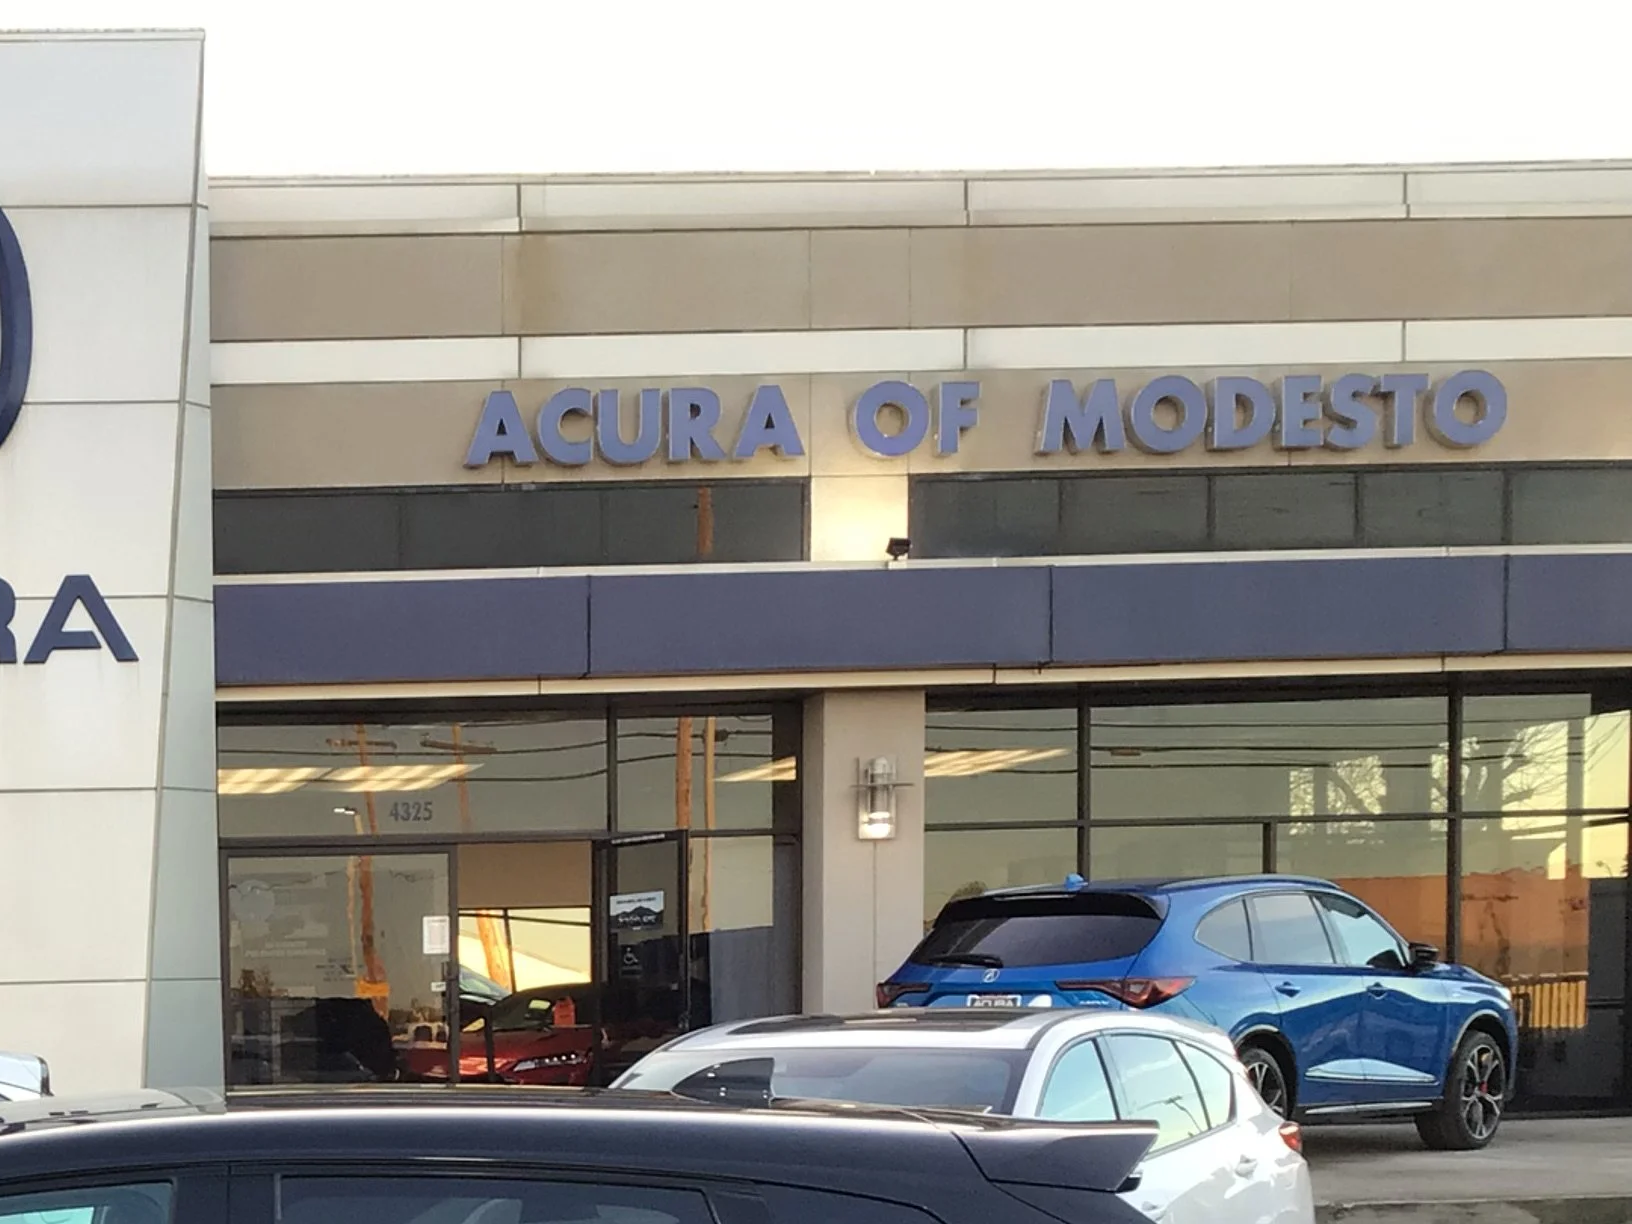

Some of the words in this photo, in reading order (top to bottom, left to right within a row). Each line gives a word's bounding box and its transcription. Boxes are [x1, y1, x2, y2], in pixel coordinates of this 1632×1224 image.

[465, 384, 805, 469] ACURA
[849, 380, 981, 457] OF
[1036, 370, 1506, 454] MODESTO
[389, 801, 433, 822] 4325
